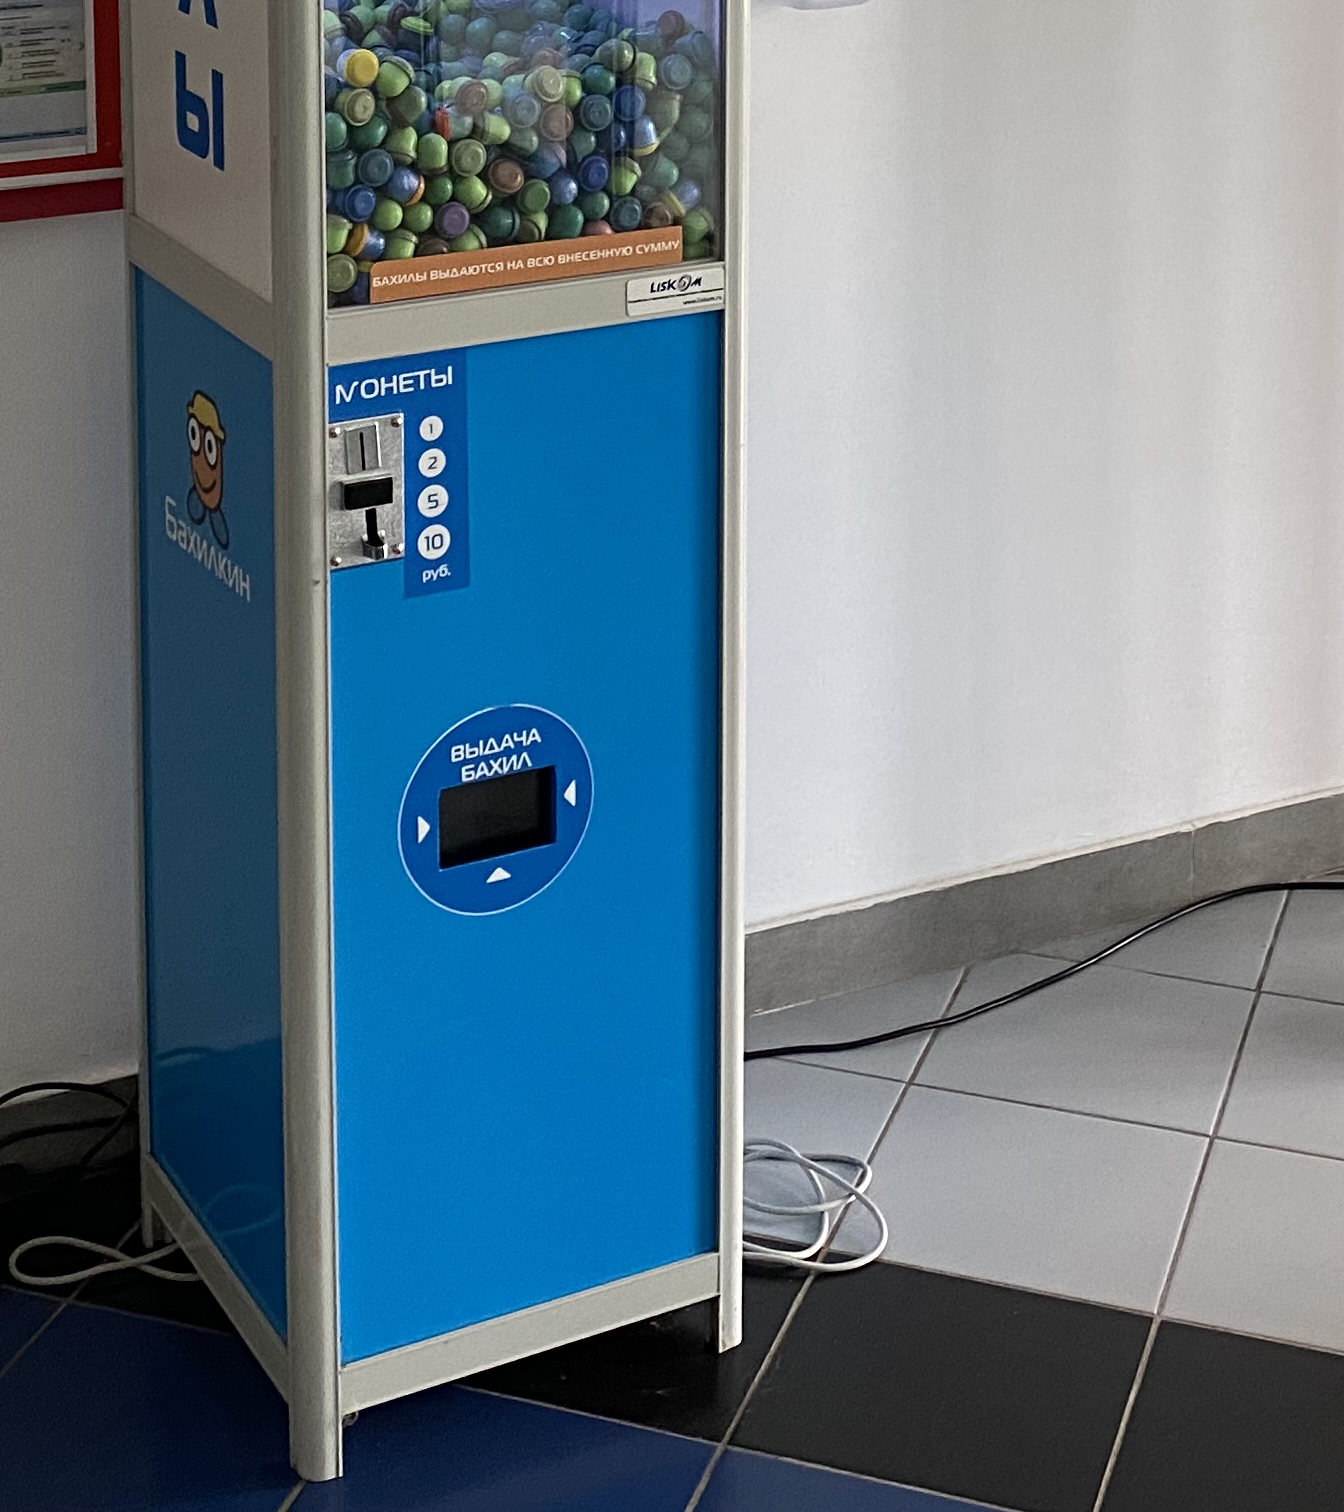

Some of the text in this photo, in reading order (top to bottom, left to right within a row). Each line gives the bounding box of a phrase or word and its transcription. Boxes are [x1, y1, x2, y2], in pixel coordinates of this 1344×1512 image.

[372, 269, 428, 287] БАХИЛЫ
[430, 261, 504, 282] ВЫДАЮТСЯ
[506, 257, 525, 271] НА
[527, 253, 555, 268] ВСЮ
[557, 245, 633, 265] ВНЕСЕННУЮ
[650, 274, 702, 294] LISKOM
[164, 494, 251, 603] Бахилкин
[422, 565, 452, 585] руб.
[450, 727, 542, 763] ВЫДАЧА
[461, 751, 533, 783] БАХИЛ
